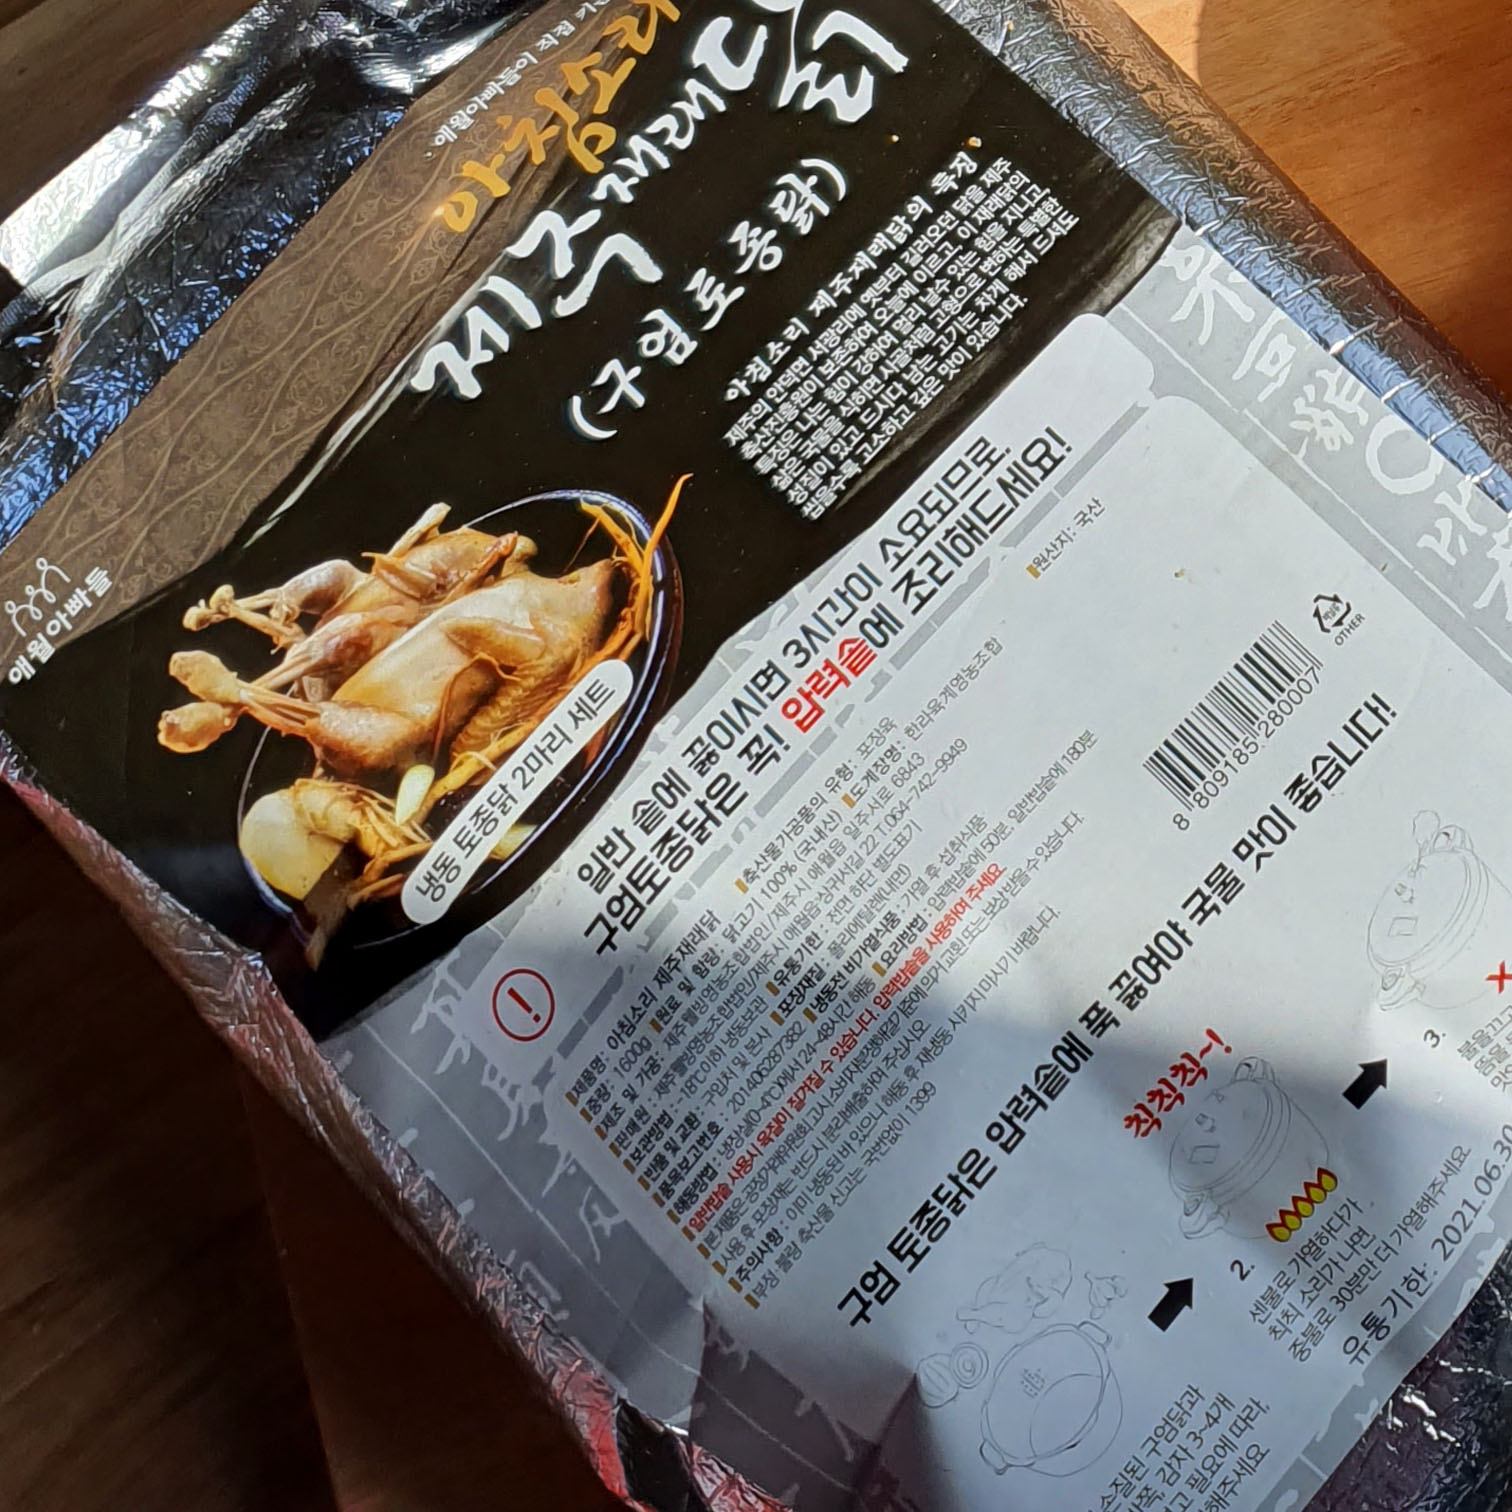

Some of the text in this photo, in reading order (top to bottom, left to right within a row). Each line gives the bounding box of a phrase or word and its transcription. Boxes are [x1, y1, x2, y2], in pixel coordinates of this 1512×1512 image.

[433, 50, 538, 146] 애월아빠들이
[534, 19, 576, 51] 직접
[723, 156, 1012, 446] 제주의 안덕면 서광리에 옛부터 길러오던 닭을 제주
[725, 150, 978, 400] 아침소리 제주재래닭의 특징
[741, 169, 1031, 459] 축산진흥원이 보존하여 오늘에 이르고, 이 재래닭의
[754, 183, 1051, 473] 특징은 나는 힘이 강하여 멀리 날수 있는 힘을 지니고,
[802, 292, 1028, 519] 씹을수록 고소하고 깊은 맛이 있습니다.
[1030, 496, 1105, 573] 원산지: 국산
[8, 566, 113, 683] 애월아빠들
[1334, 613, 1365, 646] OTHER
[577, 826, 636, 893] 일반
[631, 766, 692, 836] 솥에
[681, 659, 792, 777] 끓이시면
[782, 562, 883, 669] 3시간이
[583, 426, 1073, 963] 구엄토종닭은 꼭! 압력솥에 조리해드세요!
[824, 758, 858, 793] 유형:
[855, 716, 898, 760] 포장육
[415, 678, 616, 903] 냉동 토종닭 2마리 세트
[760, 860, 798, 899] 100%
[793, 808, 843, 863] (국내산)
[806, 837, 847, 880] 애월읍
[842, 784, 895, 841] 일주서로
[890, 751, 925, 788] 6843
[872, 862, 1007, 1011] 압력밥솥을 사용하여 주세요.
[571, 909, 720, 1099] 제품명: 아침소리 제주재래닭
[837, 692, 1397, 1327] 구엄 토종닭은 압력솥에 푹 끓여야 국물 맛이 좋습니다!
[1423, 1028, 1446, 1048] 3.
[1473, 1038, 1511, 1077] 뜸을
[1230, 1259, 1255, 1281] 2.
[1248, 1196, 1362, 1324] 센불로 가열하다가
[1268, 1224, 1377, 1341] 칙칙 소리가 나면,
[1287, 1145, 1471, 1362] 중불로 30분만 더 가열해주세요
[1342, 1262, 1437, 1364] 유통기한:
[1140, 1383, 1205, 1458] 구엄닭과
[1154, 1443, 1195, 1487] 감자
[1185, 1391, 1236, 1449] 3~4개
[1184, 1397, 1270, 1494] 필요에 따라,
